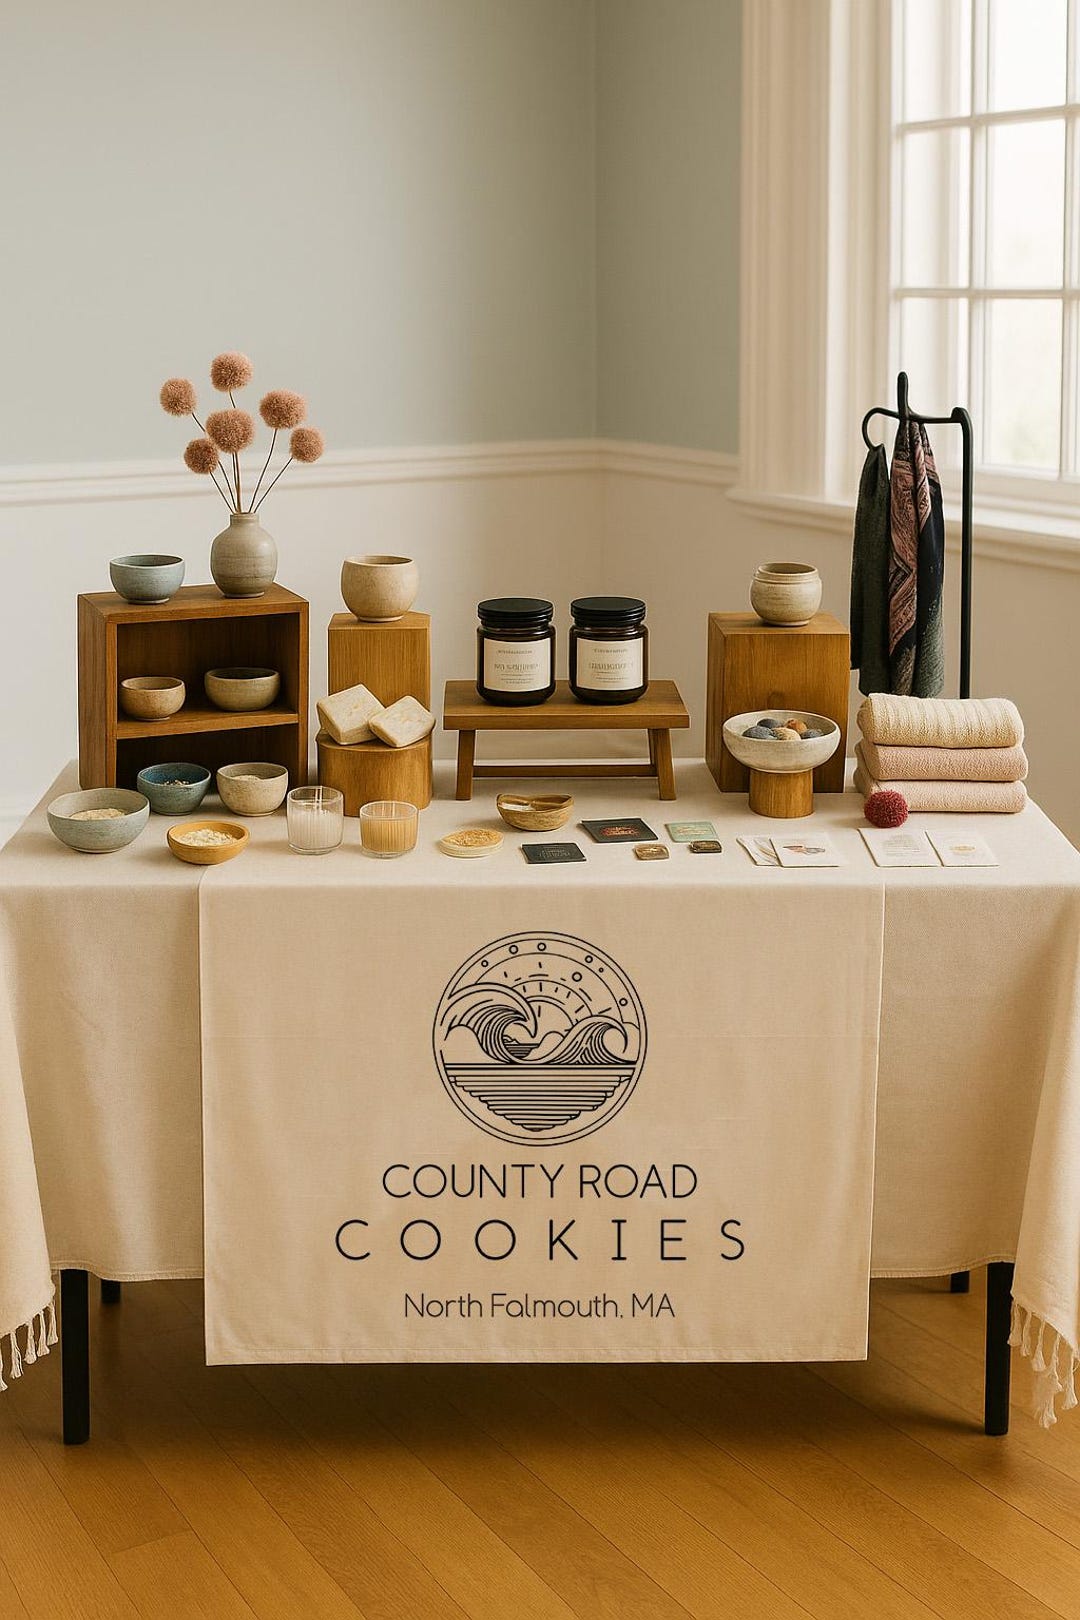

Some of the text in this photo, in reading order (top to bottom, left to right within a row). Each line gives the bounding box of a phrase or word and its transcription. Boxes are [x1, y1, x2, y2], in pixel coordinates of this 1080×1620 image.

[382, 1163, 698, 1199] COUNTY ROAD
[334, 1218, 745, 1262] COOKIES
[404, 1292, 483, 1319] North
[631, 1292, 676, 1319] MA
